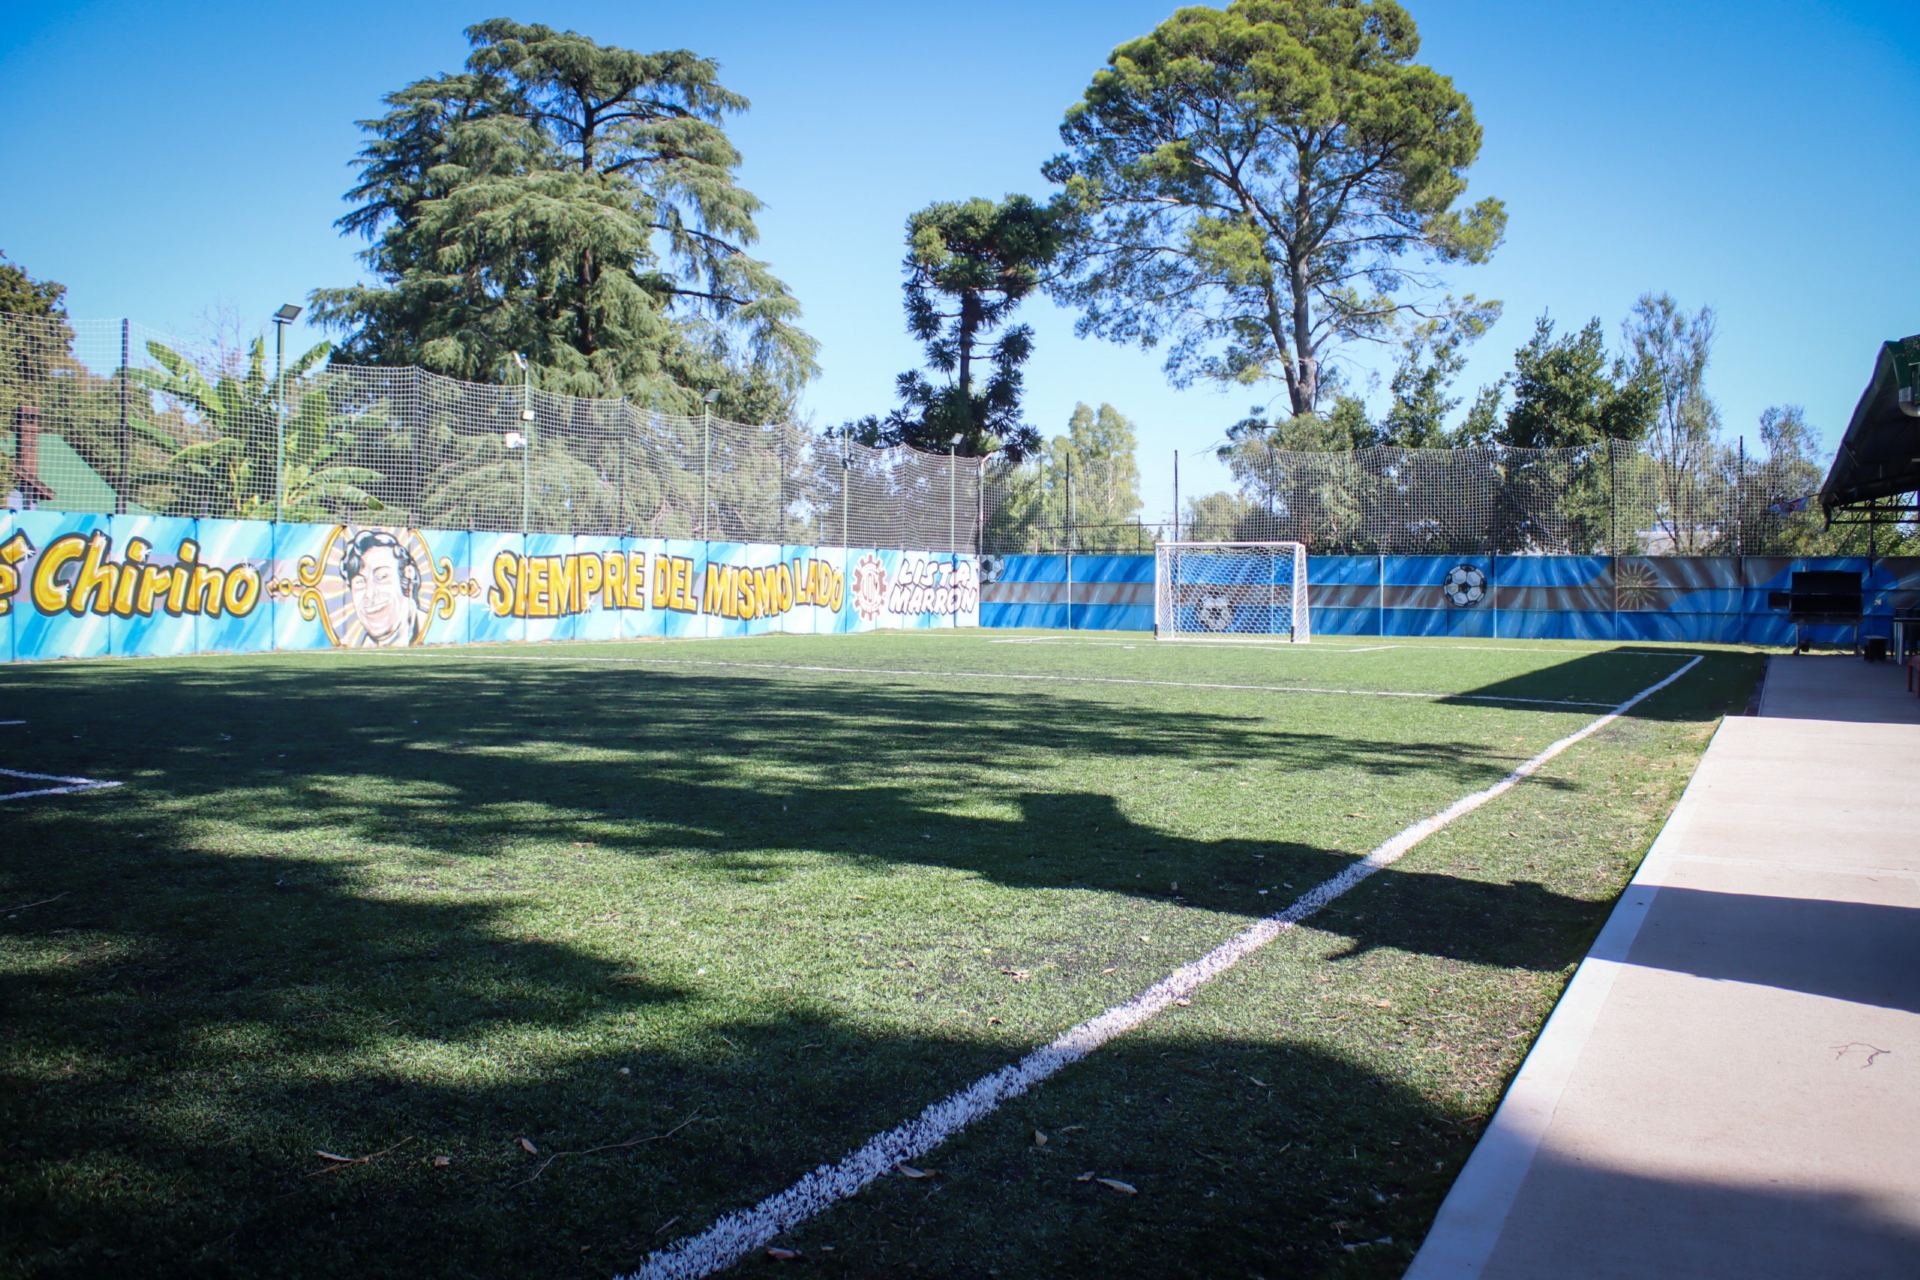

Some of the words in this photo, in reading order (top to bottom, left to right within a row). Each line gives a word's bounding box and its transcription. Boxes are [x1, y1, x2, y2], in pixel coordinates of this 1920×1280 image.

[32, 529, 261, 619] Chirino
[488, 550, 645, 618] SIEMPRE
[652, 553, 698, 614] DEL
[702, 561, 793, 621] MISMO
[793, 557, 845, 614] LADO
[898, 558, 972, 588] LISTA
[888, 583, 977, 616] MARRON
